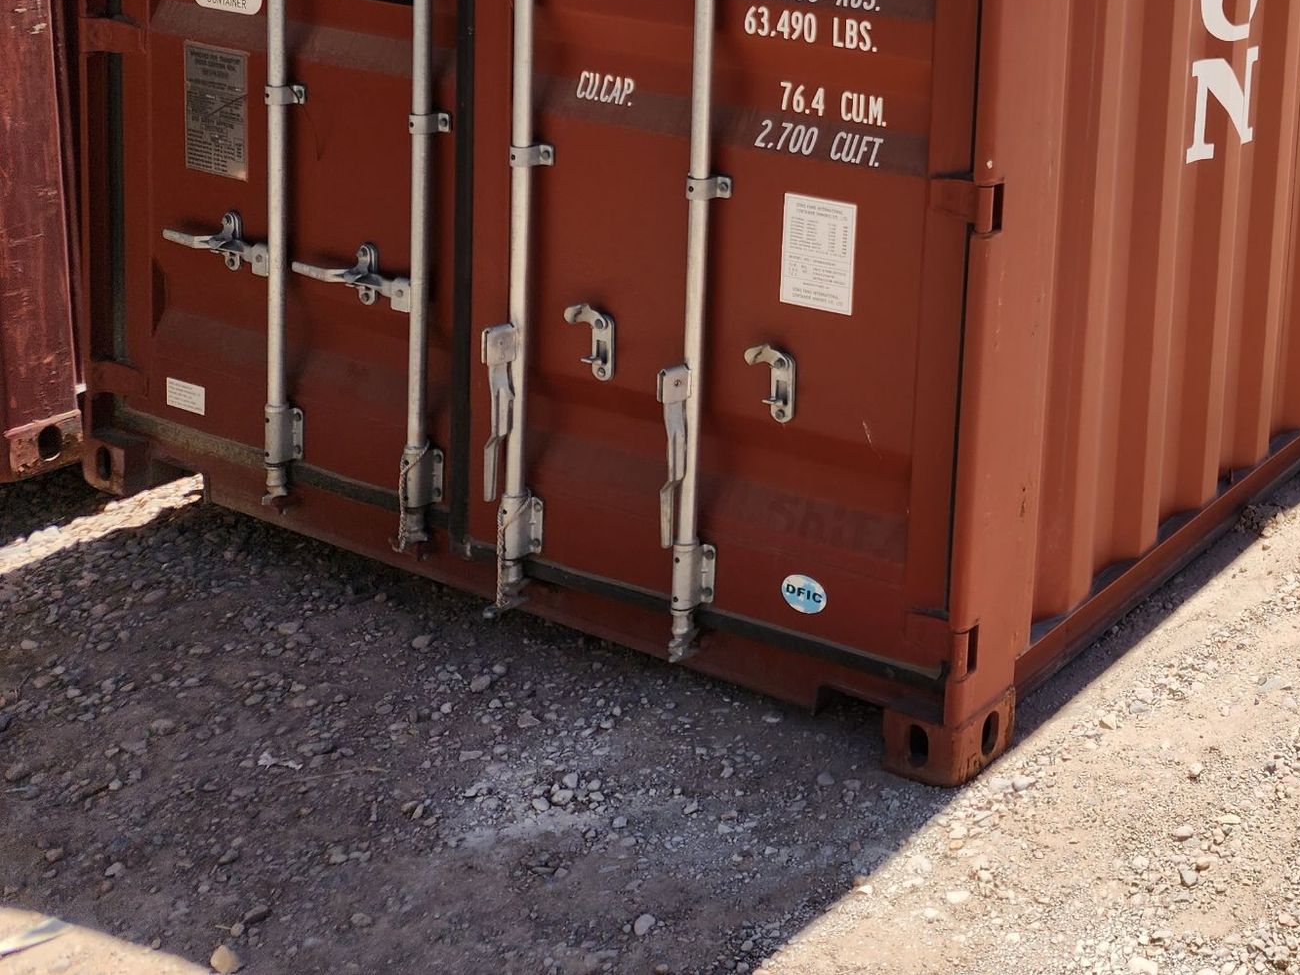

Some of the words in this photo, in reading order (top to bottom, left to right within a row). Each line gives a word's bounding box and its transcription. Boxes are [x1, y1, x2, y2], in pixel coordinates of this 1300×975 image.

[743, 5, 818, 44] 63.490
[832, 16, 879, 53] LBS.
[779, 81, 826, 117] 76.4
[785, 583, 823, 604] DFIC
